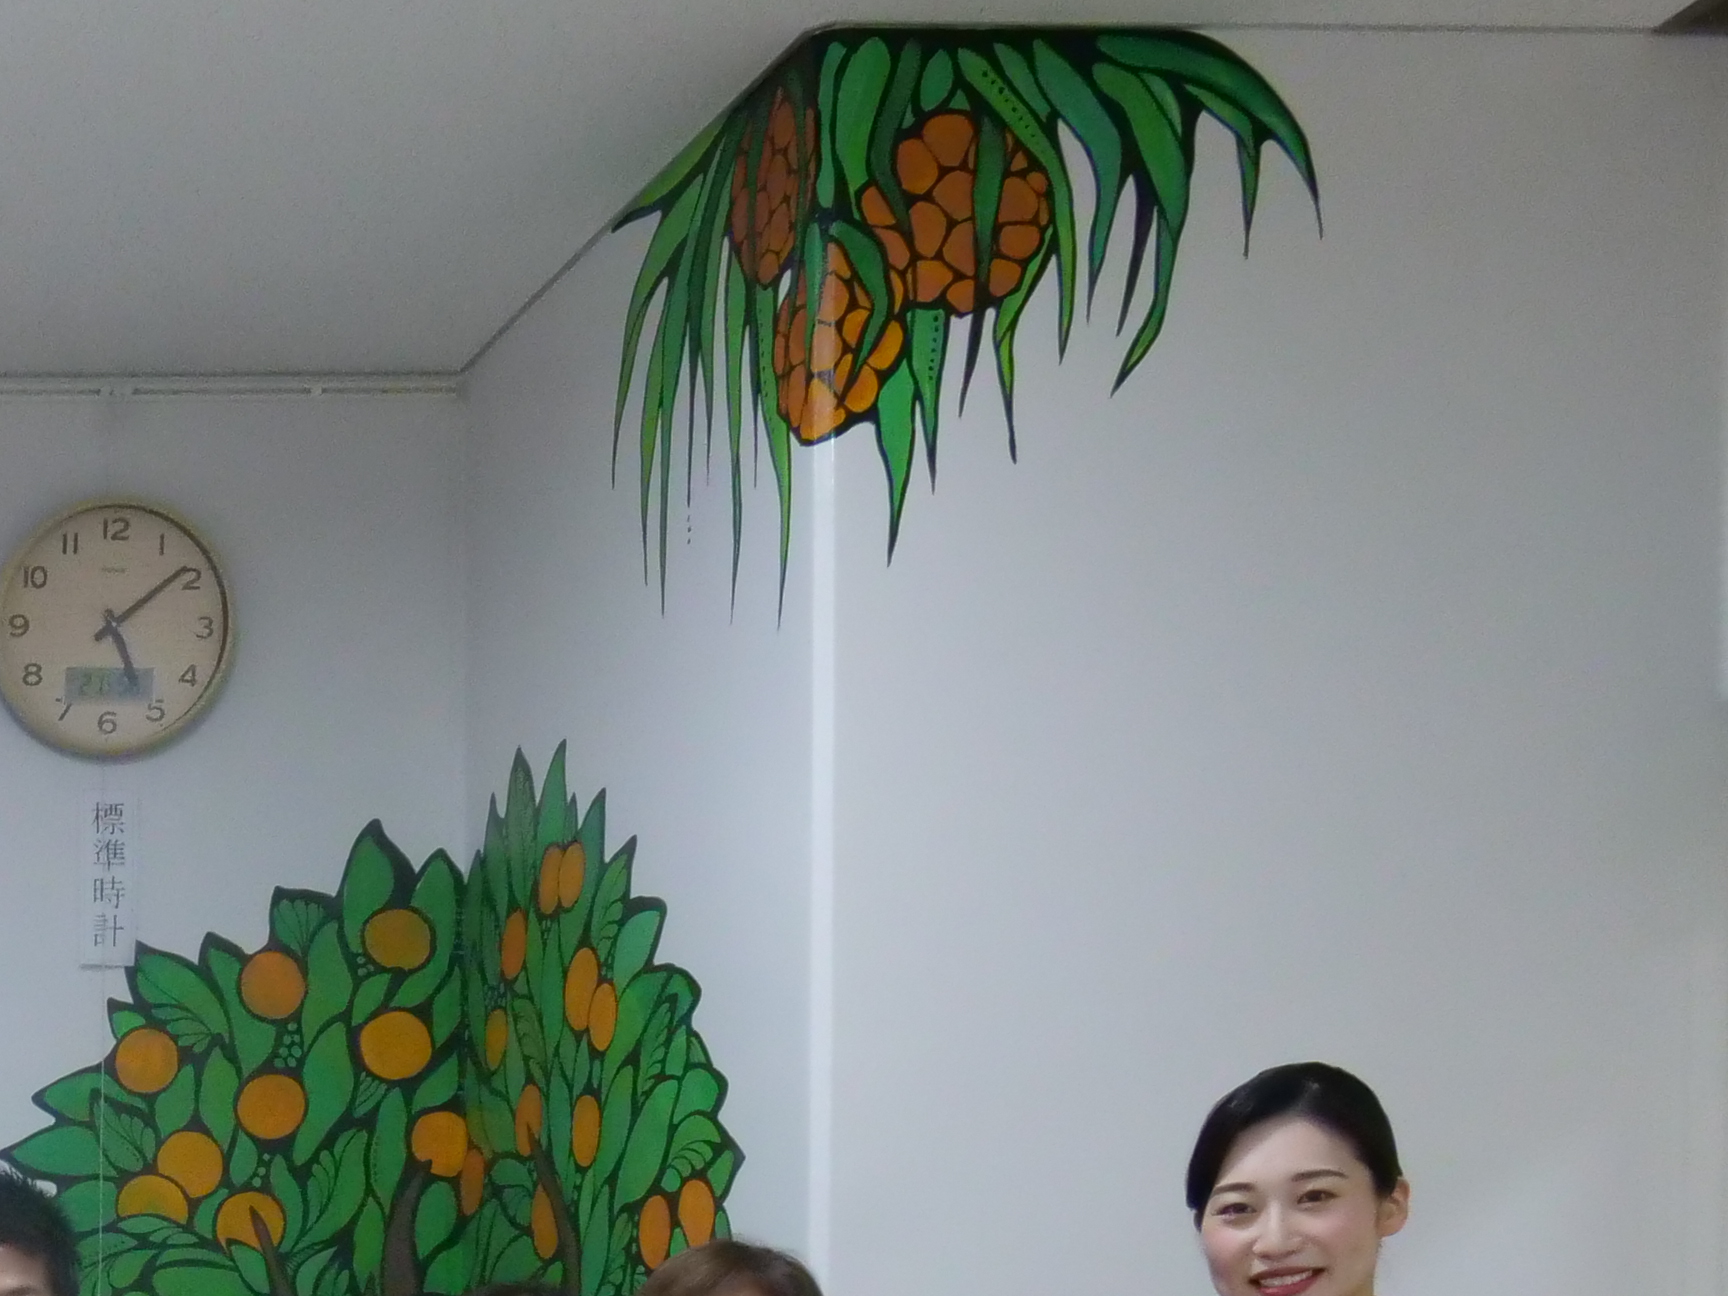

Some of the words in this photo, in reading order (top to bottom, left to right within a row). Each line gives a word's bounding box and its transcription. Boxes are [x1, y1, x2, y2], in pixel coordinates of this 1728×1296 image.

[103, 517, 130, 541] 12
[62, 532, 79, 555] 11
[159, 533, 166, 556] 1
[23, 566, 48, 589] 10
[181, 567, 202, 590] 2
[8, 614, 30, 637] 9
[196, 616, 214, 639] 3
[22, 663, 43, 686] 8
[179, 664, 198, 687] 4
[55, 697, 73, 721] 7
[146, 699, 166, 722] 5
[98, 711, 117, 734] 6
[91, 802, 126, 948] 標準時計
